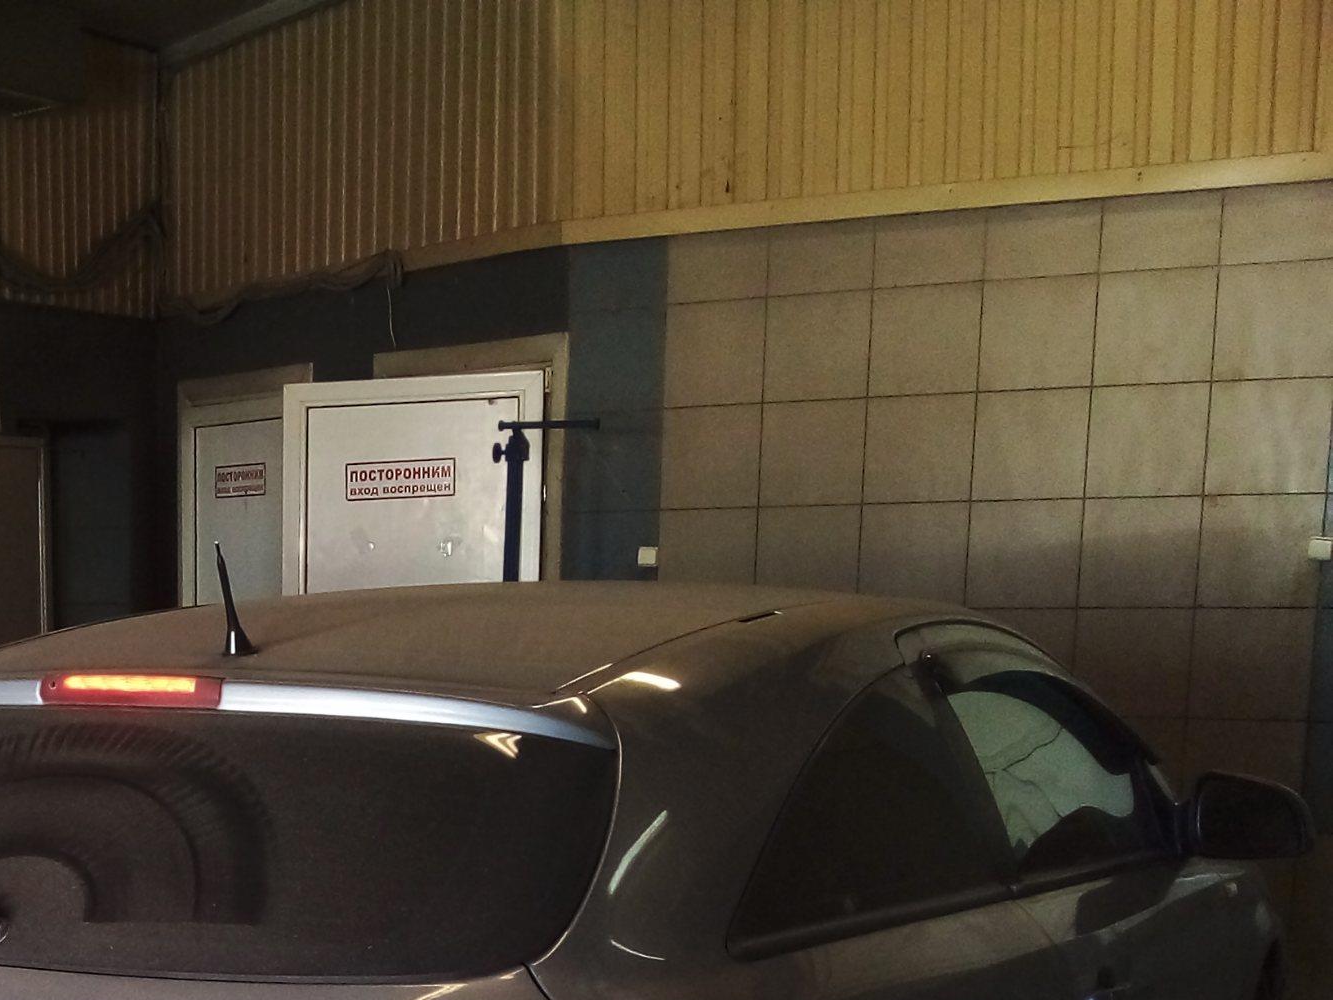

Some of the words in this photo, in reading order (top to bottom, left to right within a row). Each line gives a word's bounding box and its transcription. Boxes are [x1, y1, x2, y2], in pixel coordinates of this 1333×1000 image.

[349, 465, 452, 483] ПОСТОРОННИМ
[349, 486, 379, 496] вход
[382, 483, 452, 495] воспрещен
